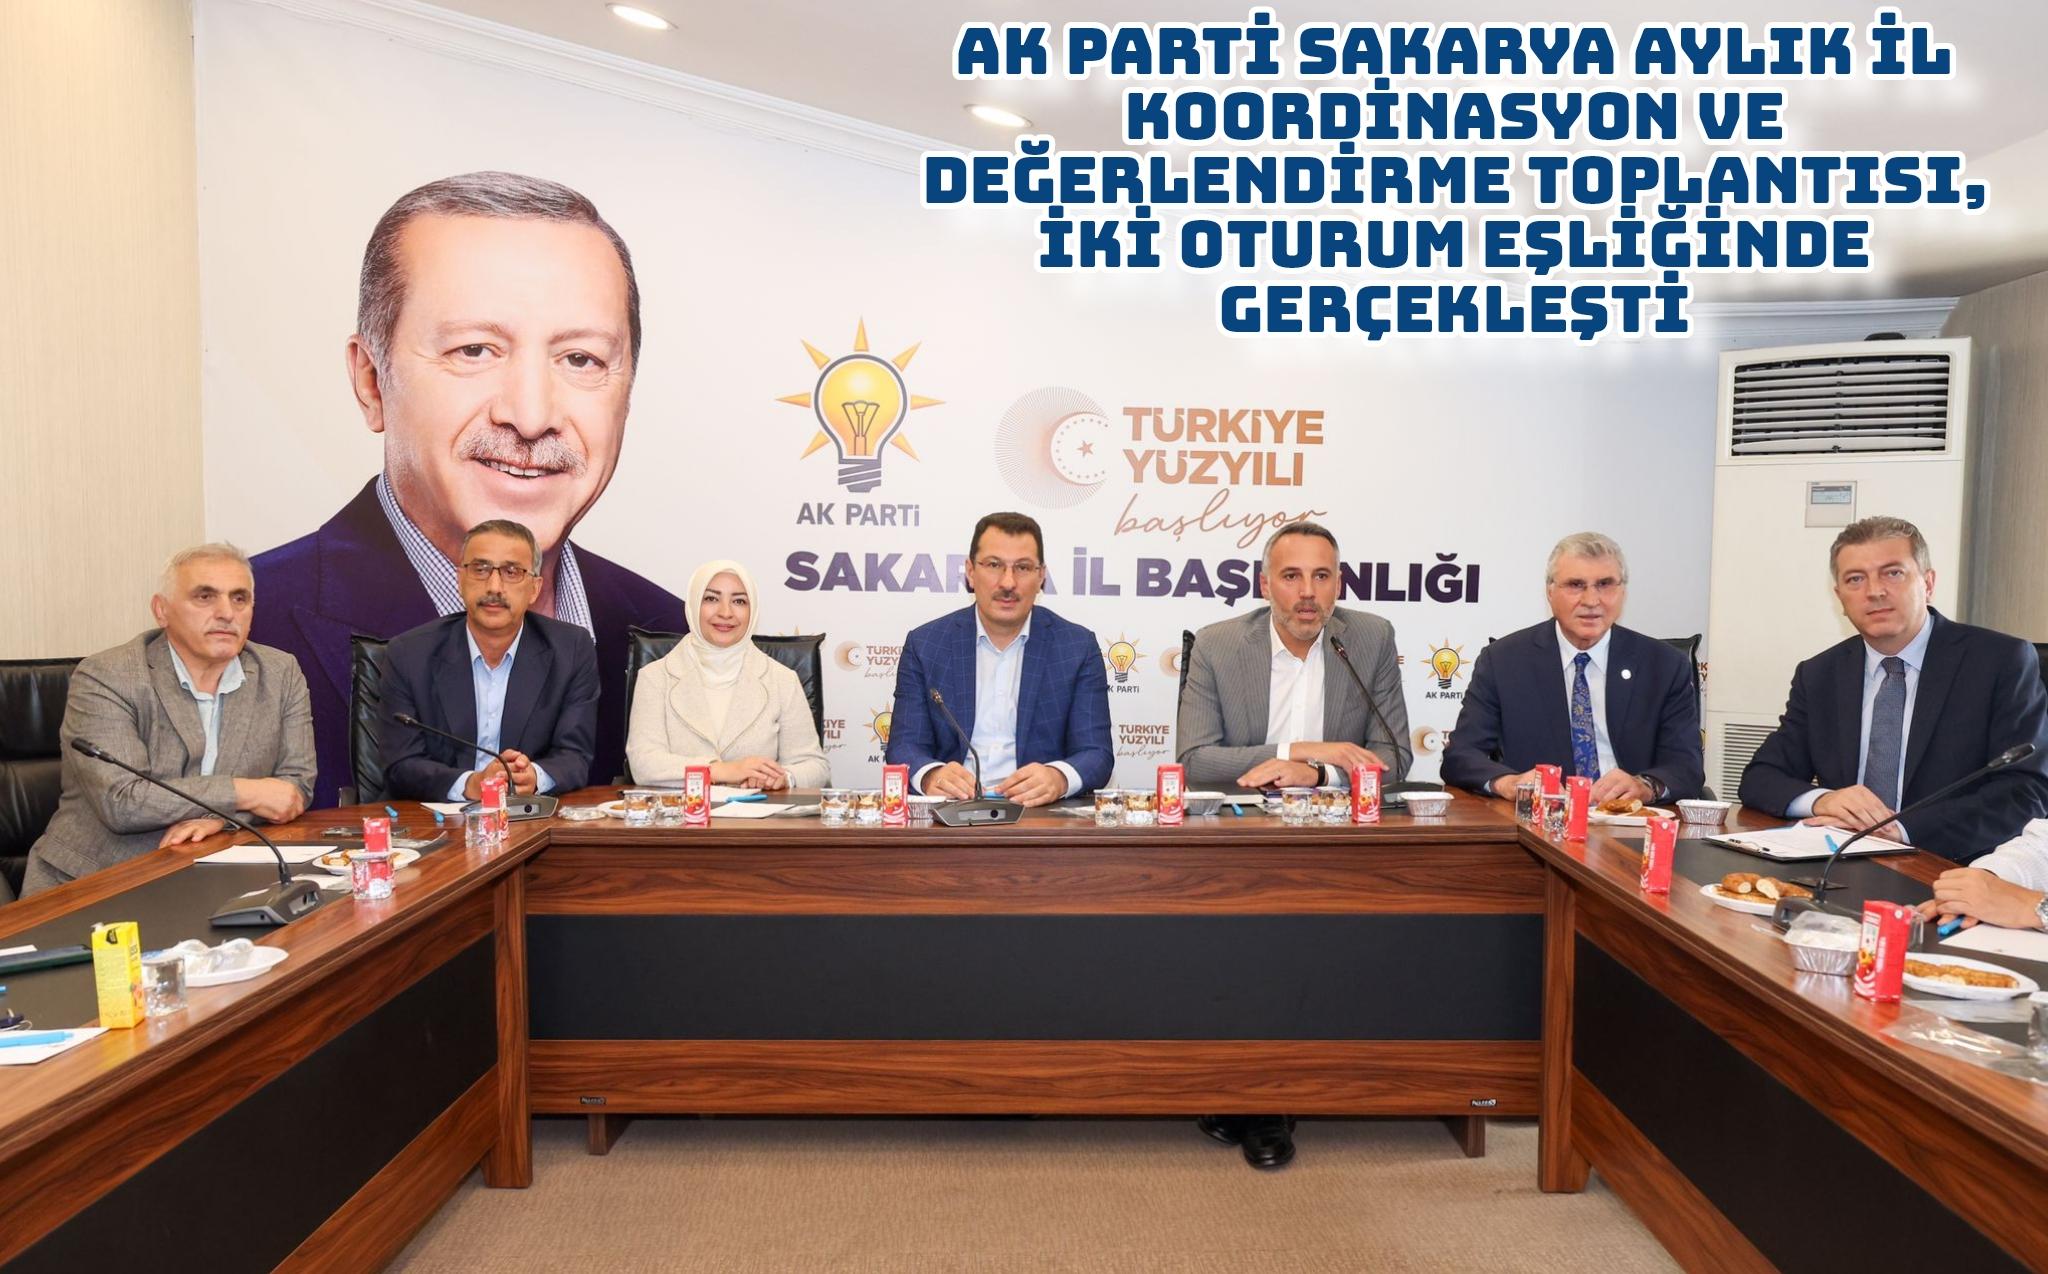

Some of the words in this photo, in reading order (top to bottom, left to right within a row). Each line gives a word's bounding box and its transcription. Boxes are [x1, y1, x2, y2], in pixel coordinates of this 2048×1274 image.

[1122, 448, 1305, 487] YÜZYILI
[796, 502, 836, 525] AK
[1072, 546, 1121, 597] İL
[1136, 552, 1481, 608] BAŞNLIĞI
[1425, 691, 1438, 699] AK
[867, 755, 880, 763] AK
